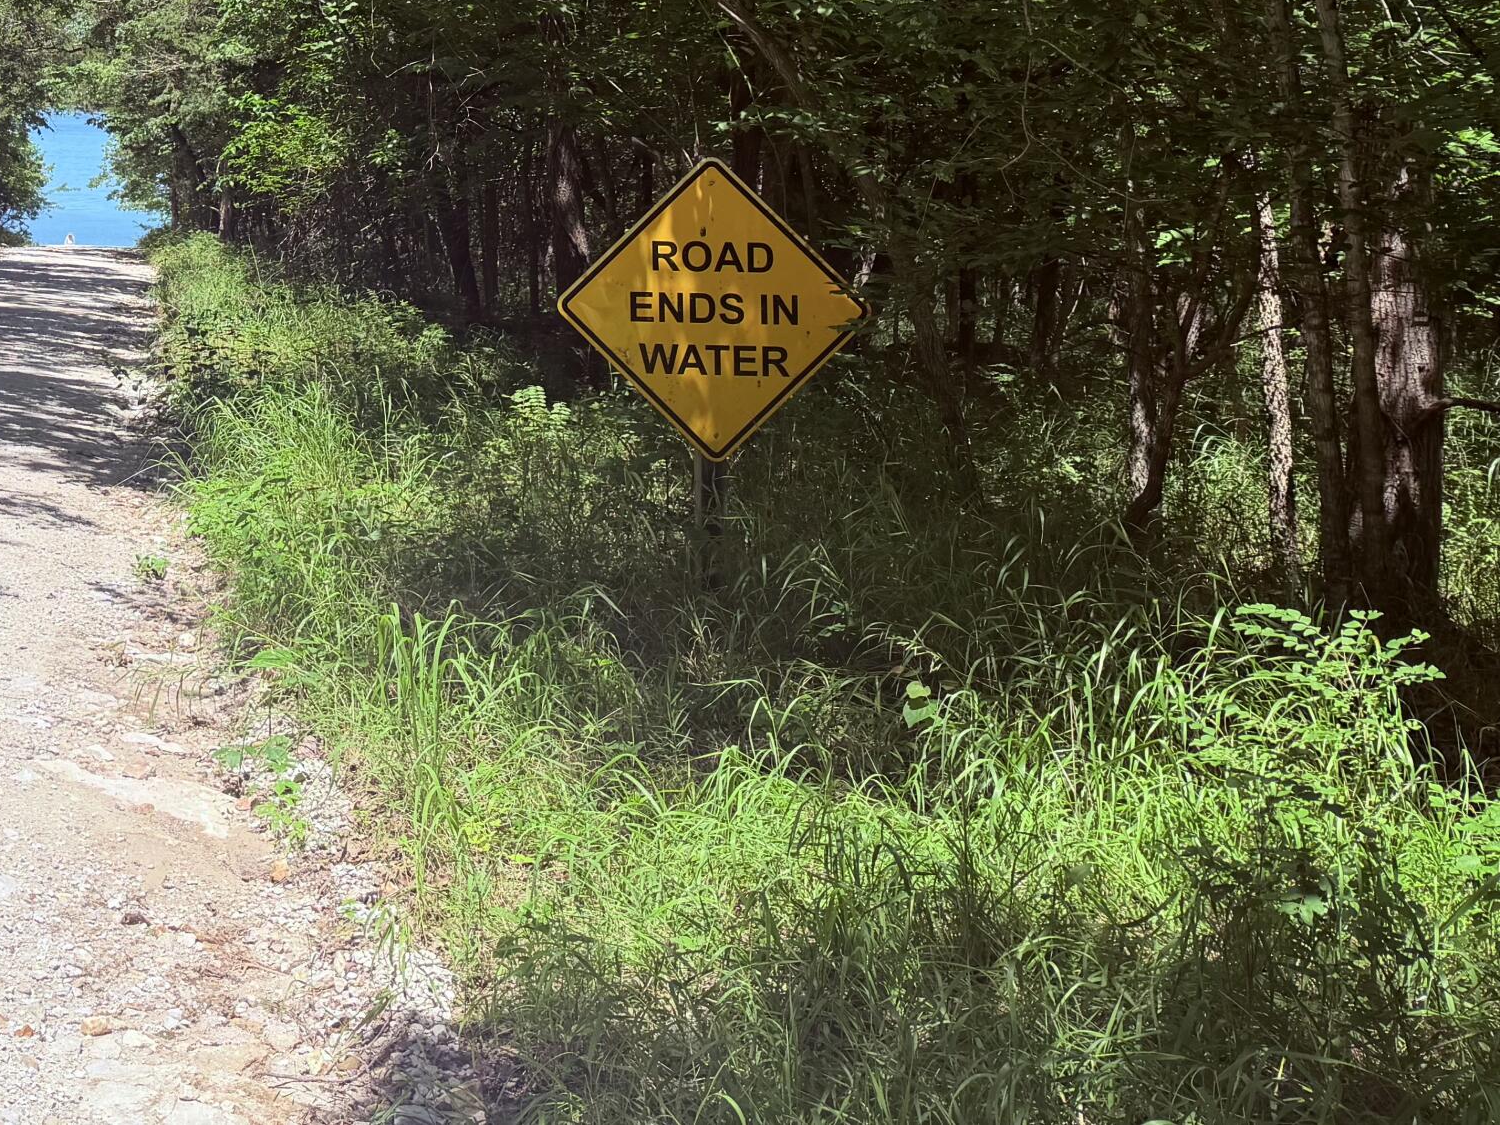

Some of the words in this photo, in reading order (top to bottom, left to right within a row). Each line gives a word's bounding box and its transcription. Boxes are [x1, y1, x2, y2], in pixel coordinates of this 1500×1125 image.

[651, 240, 774, 273] ROAD
[629, 291, 745, 324] ENDS
[760, 294, 799, 326] IN
[638, 343, 790, 377] WATER
